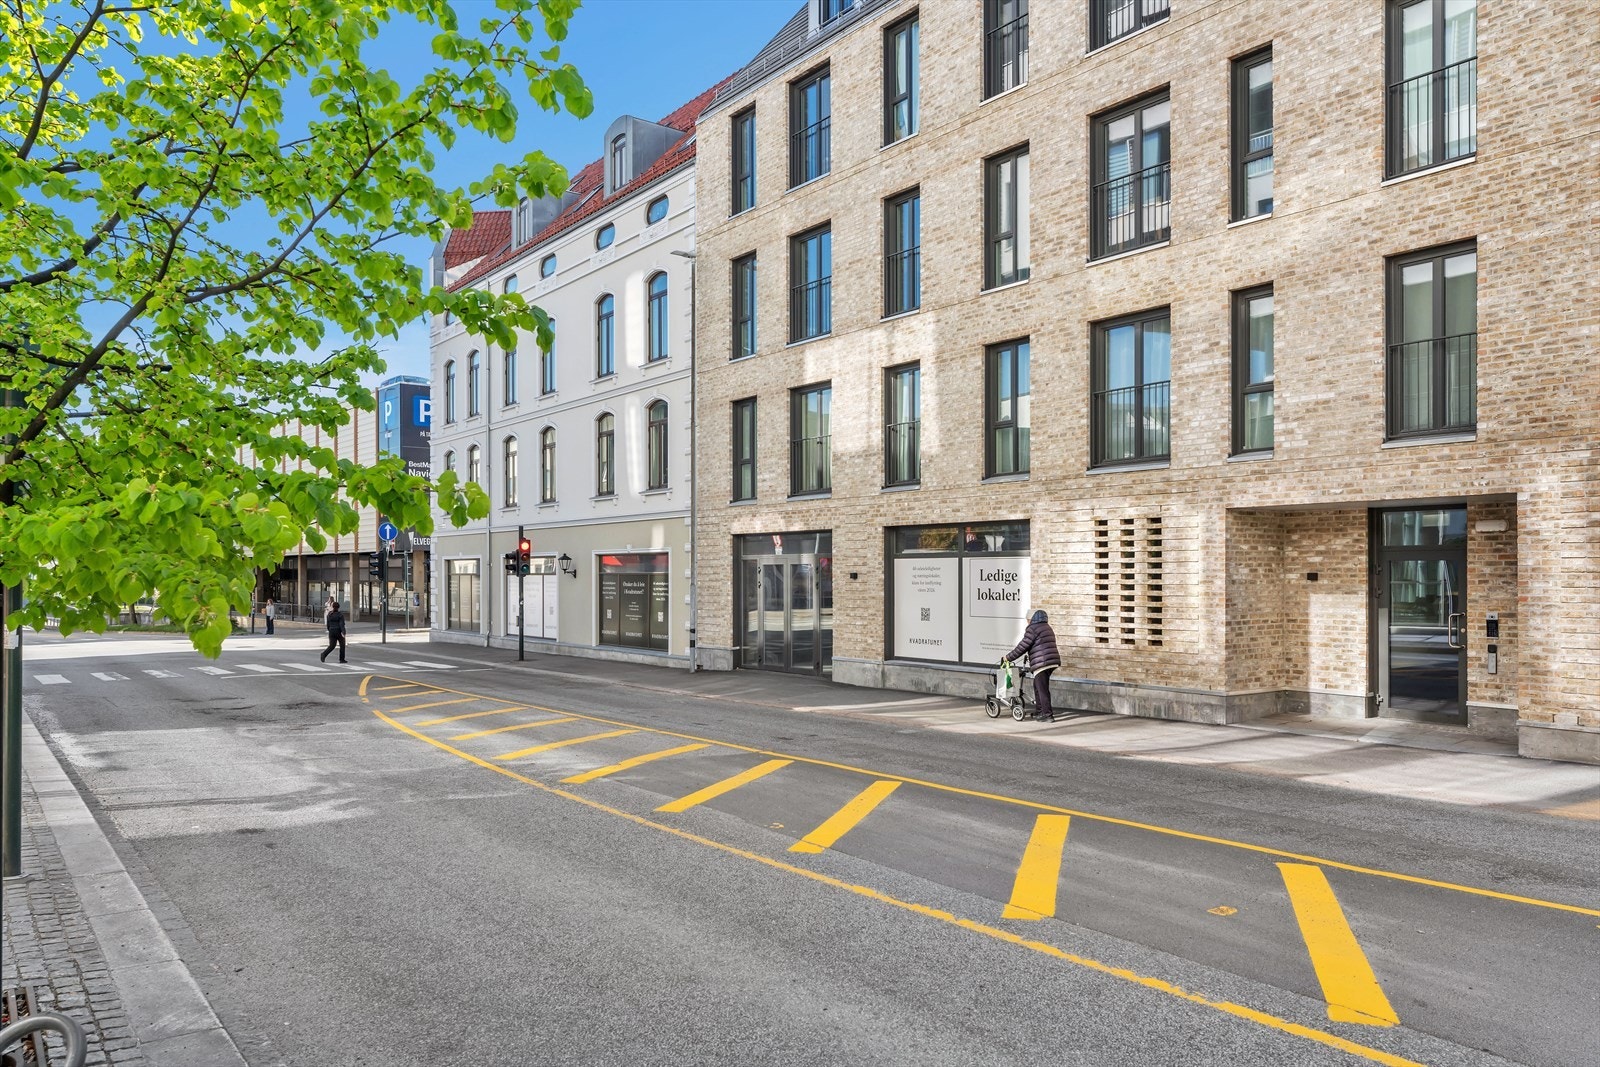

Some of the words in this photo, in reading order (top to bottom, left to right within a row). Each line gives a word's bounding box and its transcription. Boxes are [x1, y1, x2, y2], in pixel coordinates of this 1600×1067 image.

[385, 400, 392, 424] P
[420, 399, 431, 423] P
[980, 568, 1018, 585] Ledige
[977, 587, 1021, 601] lokaler!
